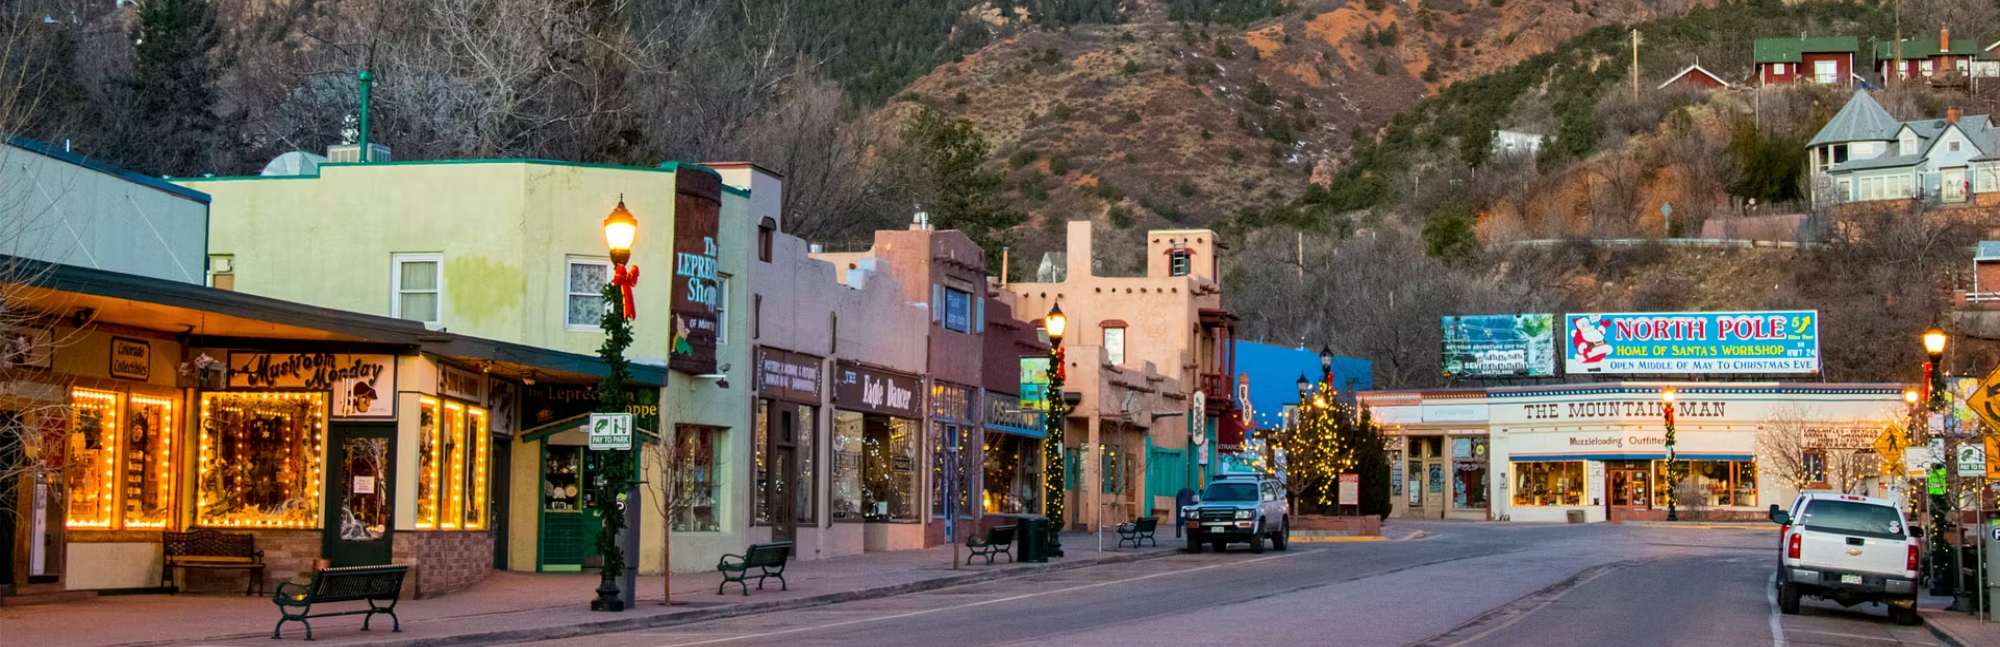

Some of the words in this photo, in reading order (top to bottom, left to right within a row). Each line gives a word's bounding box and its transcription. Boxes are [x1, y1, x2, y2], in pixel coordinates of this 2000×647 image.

[689, 319, 697, 329] OF
[1614, 317, 1705, 340] NORTH
[1717, 316, 1787, 340] POLE
[118, 342, 145, 358] Colorado
[1616, 345, 1648, 356] HOME
[1652, 345, 1667, 356] OF
[1721, 344, 1785, 356] WORKSHOP
[1805, 349, 1816, 357] 24
[114, 360, 148, 376] Collectibles
[248, 353, 336, 386] Mushroom
[1610, 361, 1634, 370] OPEN
[1638, 361, 1672, 370] MIDDLE
[1676, 361, 1688, 370] OF
[1692, 361, 1713, 370] MAY
[1733, 360, 1790, 369] CHRISTMAS
[1793, 360, 1812, 369] EVE
[305, 358, 383, 390] Monday
[845, 370, 857, 384] THE
[548, 386, 635, 403] Leprecn
[862, 374, 884, 410] Eagle
[887, 378, 911, 410] Dancer
[1524, 403, 1559, 419] THE
[1568, 402, 1665, 418] MOUNTAIN
[1679, 402, 1726, 417] MAN
[592, 435, 603, 444] PAY
[604, 435, 613, 444] TO
[613, 435, 629, 444] PARK
[1569, 437, 1623, 448] Muzzleloading
